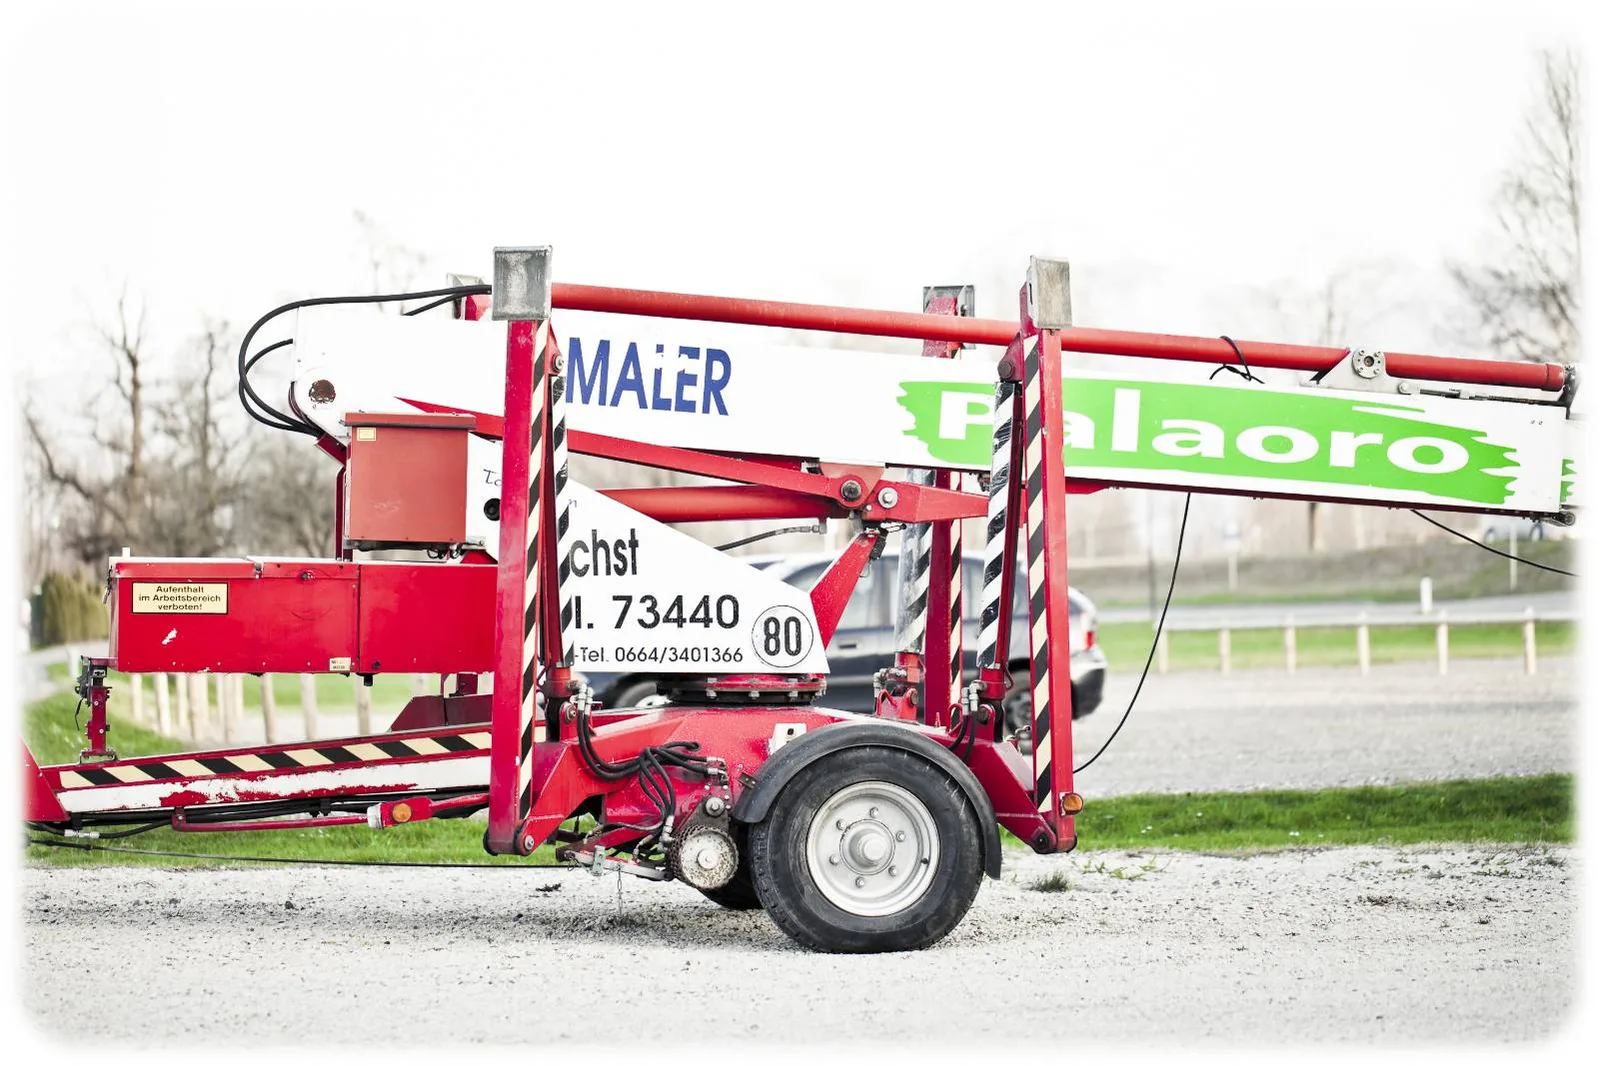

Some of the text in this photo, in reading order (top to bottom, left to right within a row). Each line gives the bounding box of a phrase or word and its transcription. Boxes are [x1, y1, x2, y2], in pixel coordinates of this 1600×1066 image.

[570, 528, 639, 577] chst
[139, 594, 221, 602] im Arbeitsbereich
[157, 603, 203, 611] verboten!
[612, 594, 740, 629] 73440
[763, 616, 802, 657] 80
[615, 647, 743, 664] 0664/3401366
